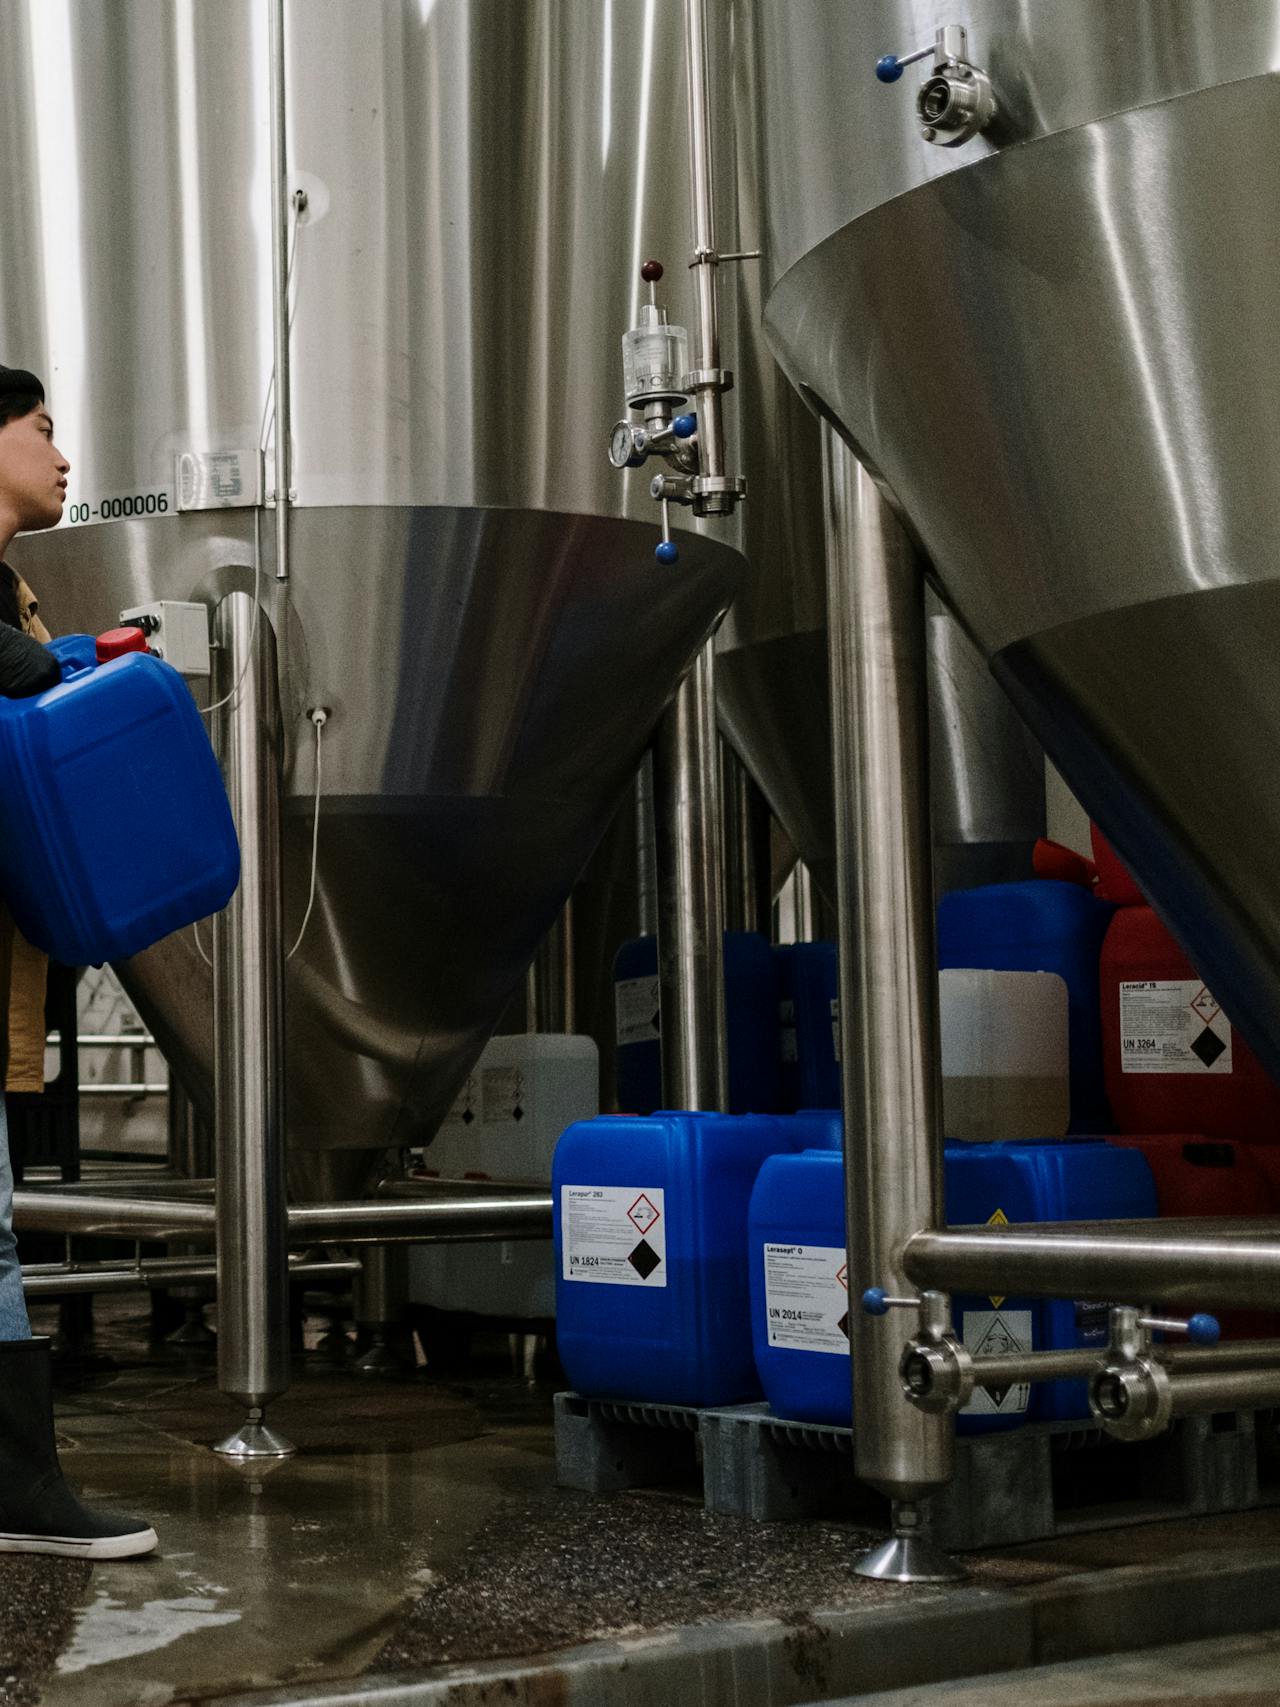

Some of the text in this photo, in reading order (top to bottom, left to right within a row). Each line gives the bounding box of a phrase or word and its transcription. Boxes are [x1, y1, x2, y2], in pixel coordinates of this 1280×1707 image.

[70, 493, 169, 523] 00-000006
[1123, 1039, 1156, 1049] UN 3264
[570, 1256, 580, 1265] UN
[581, 1256, 599, 1266] 1824
[769, 1308, 780, 1319] UN
[782, 1309, 802, 1321] 2014
